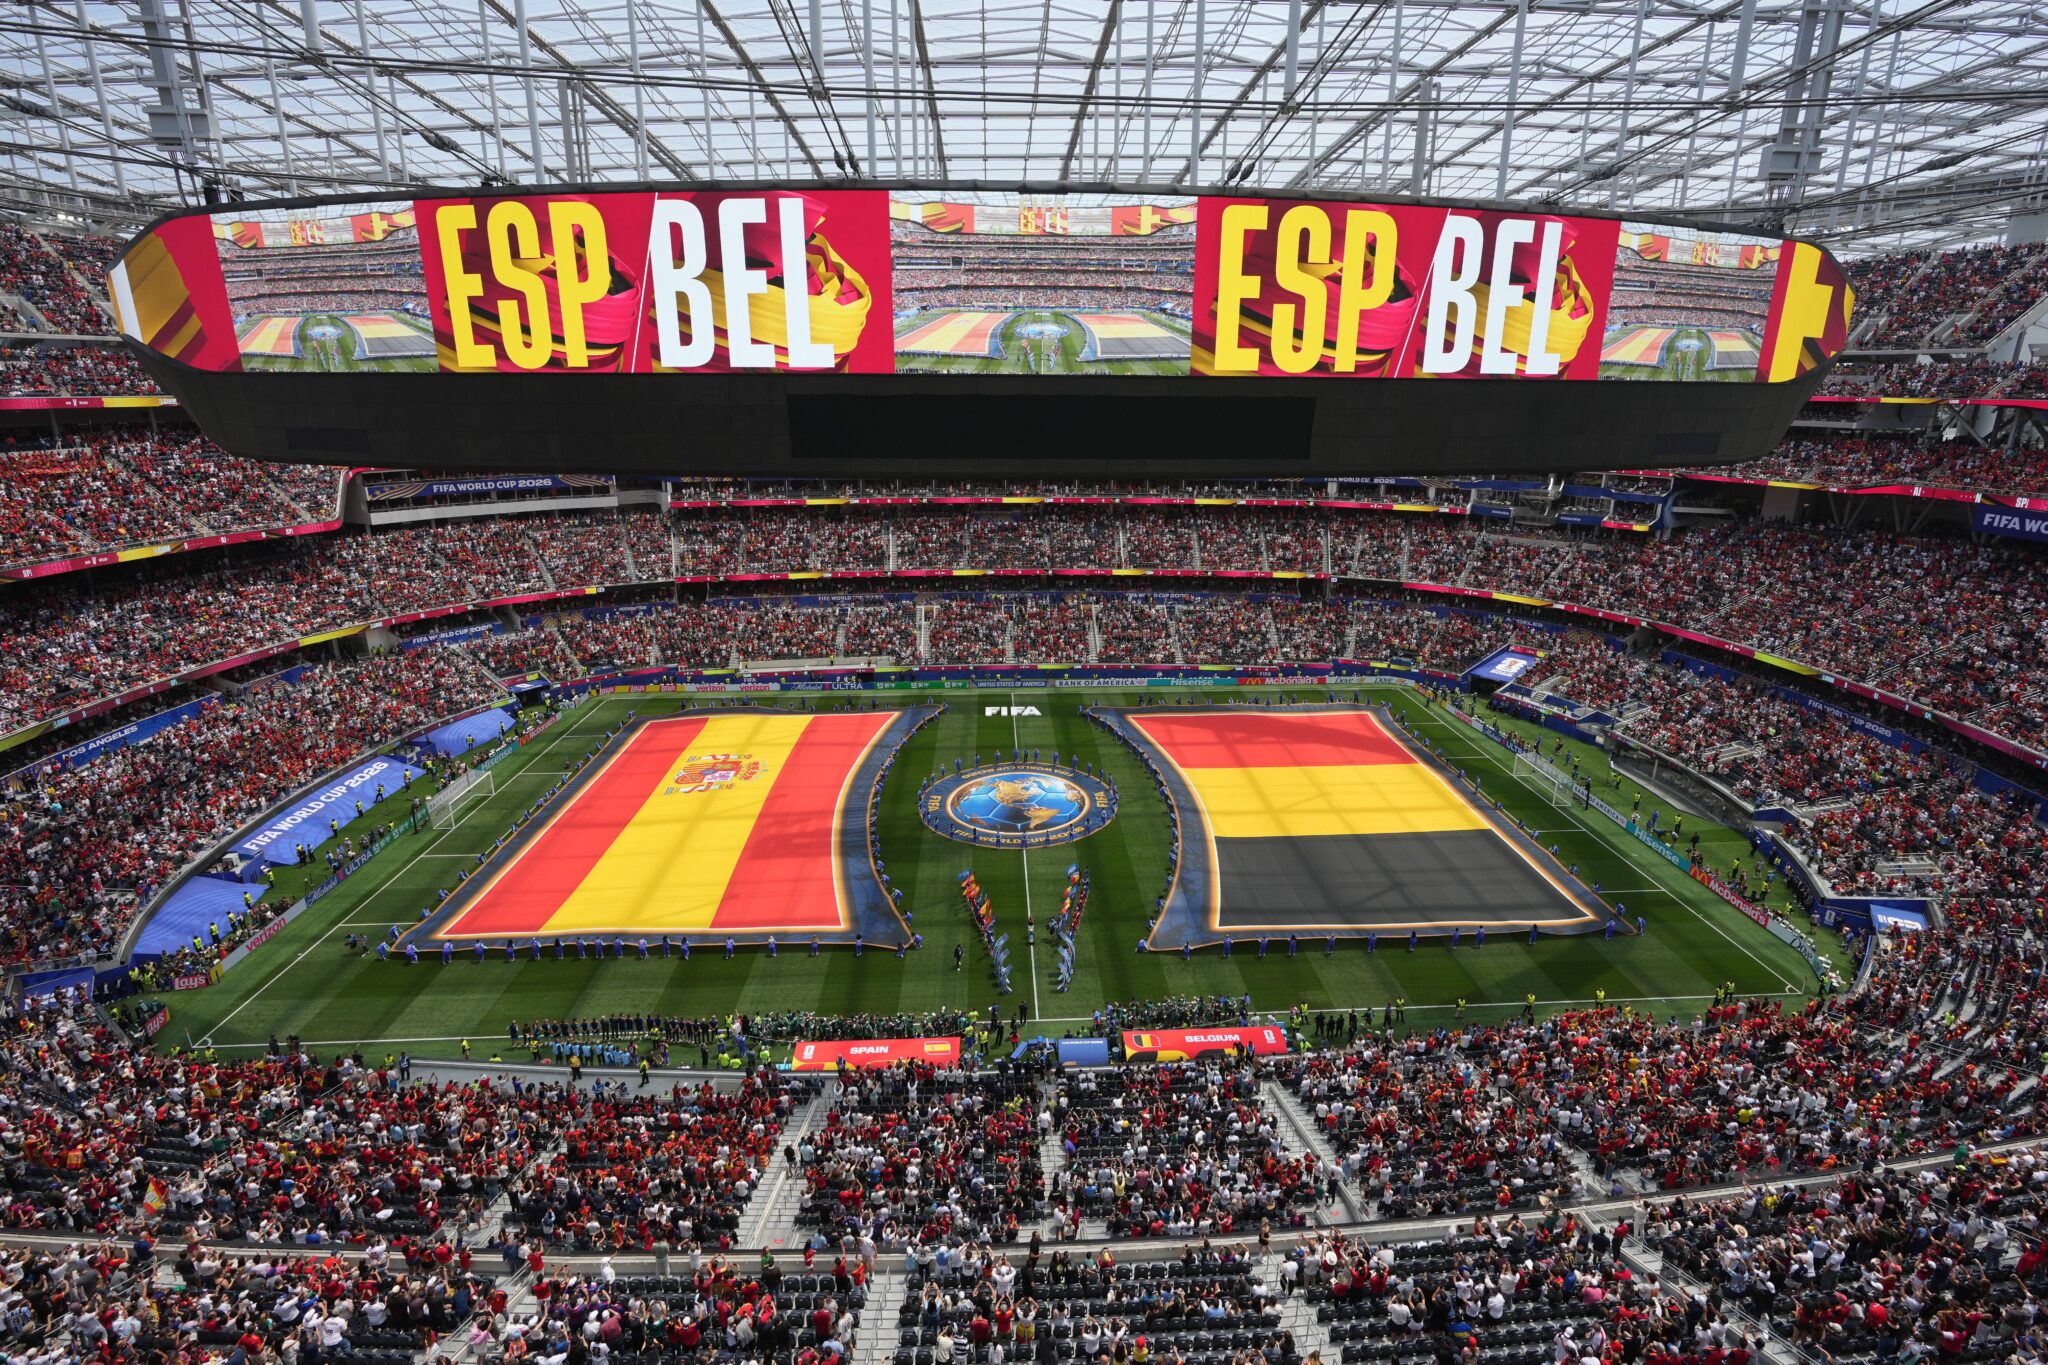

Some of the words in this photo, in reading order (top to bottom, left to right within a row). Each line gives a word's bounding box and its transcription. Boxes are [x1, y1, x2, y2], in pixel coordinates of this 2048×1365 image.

[436, 201, 611, 369] ESP
[649, 198, 836, 368] BEL
[1214, 205, 1398, 373] ESP
[1422, 215, 1563, 375] BEL
[433, 484, 457, 492] FIFA
[457, 482, 495, 491] WORLD
[496, 480, 517, 488] CUP
[517, 478, 552, 487] 2026
[1983, 513, 2020, 530] FIFA
[412, 636, 428, 644] FIFA
[455, 628, 469, 636] CUP
[832, 681, 863, 690] ULTRA
[1171, 678, 1214, 686] Hisense
[1265, 676, 1318, 685] McDonald's
[984, 706, 1042, 717] FIFA
[88, 725, 138, 751] ANGELES
[1865, 721, 1892, 738] 2026
[481, 746, 513, 771] Hisense
[243, 830, 282, 851] FIFA
[273, 801, 325, 831] WORLD
[320, 785, 348, 802] CUP
[344, 761, 389, 788] 2026
[928, 795, 941, 813] FIFA
[1094, 791, 1109, 808] FIFA
[1634, 827, 1680, 866] Hisense
[344, 850, 373, 876] ULTRA
[1709, 880, 1766, 924] McDonald's
[245, 917, 287, 952] verizon
[1185, 1034, 1240, 1043] BELGIUM
[850, 1046, 889, 1055] SPAIN
